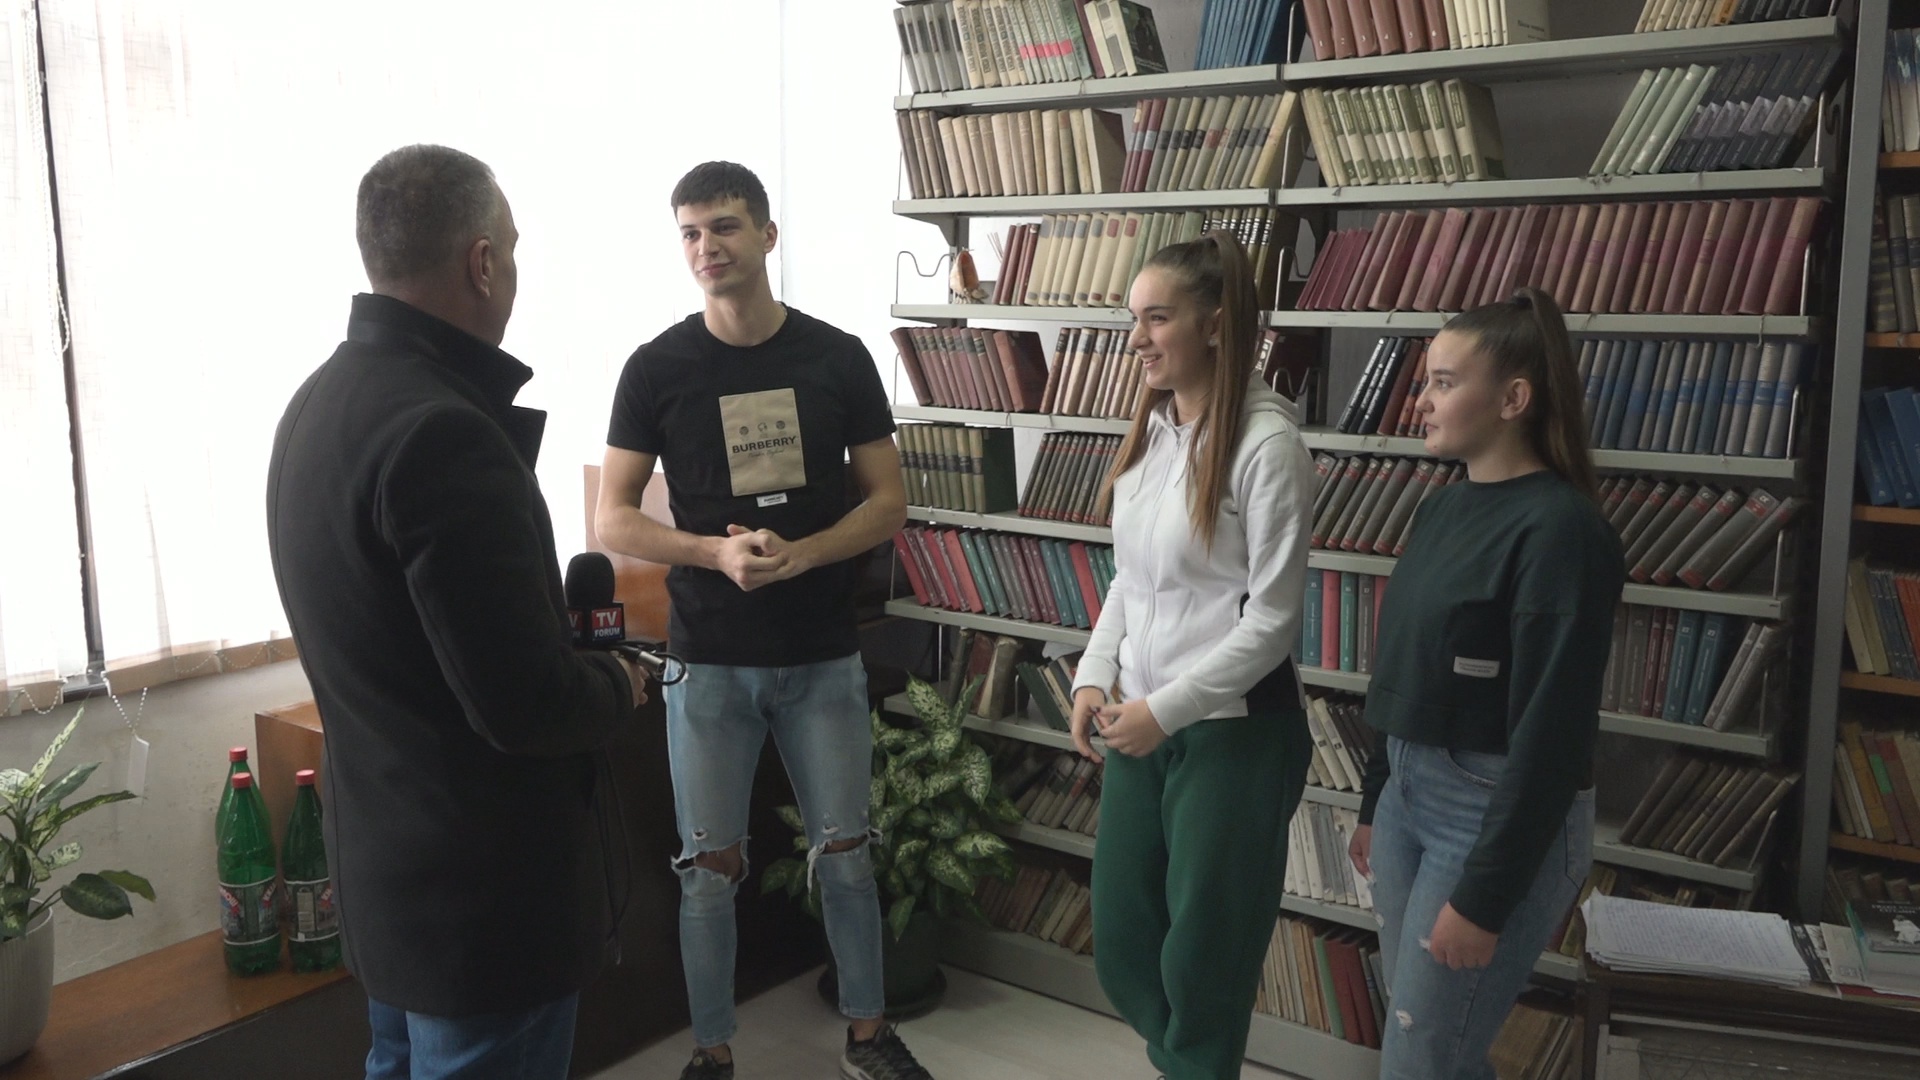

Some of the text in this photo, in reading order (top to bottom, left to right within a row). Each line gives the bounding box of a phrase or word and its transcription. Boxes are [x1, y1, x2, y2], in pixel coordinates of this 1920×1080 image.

[733, 436, 796, 454] BURBERRY
[568, 613, 578, 628] V
[596, 611, 617, 627] TV
[594, 627, 620, 638] FORUM
